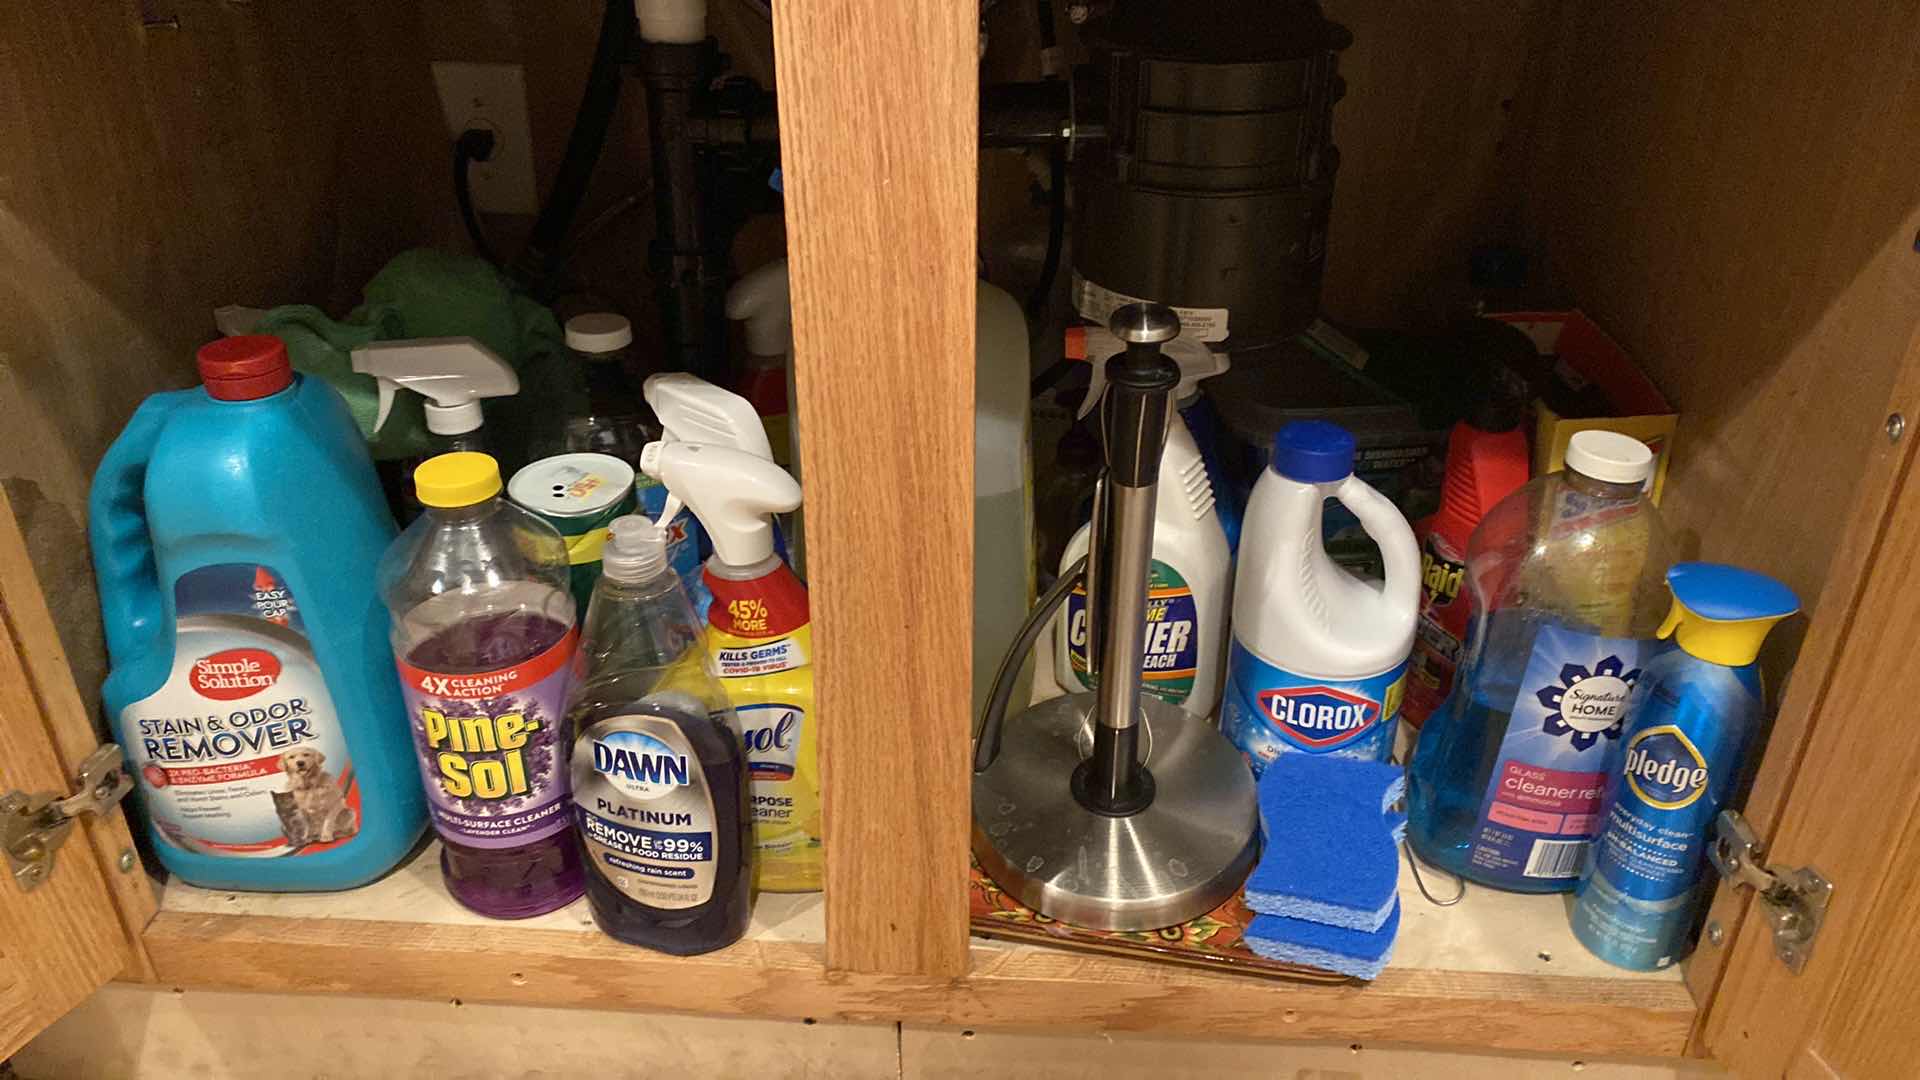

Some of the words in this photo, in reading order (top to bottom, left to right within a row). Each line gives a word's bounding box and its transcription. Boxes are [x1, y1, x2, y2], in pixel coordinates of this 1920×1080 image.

[1423, 554, 1464, 599] Raid
[256, 590, 286, 600] EASY
[256, 600, 288, 609] POUR
[263, 608, 286, 618] CAP
[728, 598, 768, 619] 45%
[733, 619, 768, 631] MORE
[719, 651, 748, 661] KILLS
[750, 644, 788, 659] GERMS
[1142, 654, 1177, 669] EACH
[197, 658, 261, 675] Simple
[197, 673, 273, 689] Solution
[421, 676, 451, 696] 4X
[451, 671, 518, 688] CLEANING
[453, 684, 504, 697] ACTION
[1569, 688, 1628, 703] Signature
[138, 717, 202, 735] STAIN
[207, 715, 225, 731] &
[229, 698, 308, 728] ODOR
[1271, 694, 1369, 731] CLOROX
[1572, 704, 1616, 717] HOME
[143, 718, 315, 761] REMOVER
[422, 708, 541, 754] Pine-
[744, 711, 794, 753] sol
[593, 741, 688, 785] DAWN
[1509, 765, 1547, 781] GLASS
[1624, 749, 1708, 793] pledge
[437, 749, 530, 800] Sol
[626, 783, 650, 792] ULTRA
[1505, 777, 1578, 799] cleaner
[751, 795, 793, 807] RPOSE
[513, 803, 562, 825] CLEANER
[597, 798, 692, 826] PLATINUM
[751, 806, 793, 818] eaner
[586, 817, 652, 850] REMOVE
[664, 838, 704, 853] 99%
[1610, 811, 1689, 852] multisurface
[593, 834, 623, 850] GREASE
[632, 848, 660, 858] FOOD
[661, 852, 704, 861] RESIDUE
[646, 866, 662, 875] rain
[664, 869, 688, 877] scent
